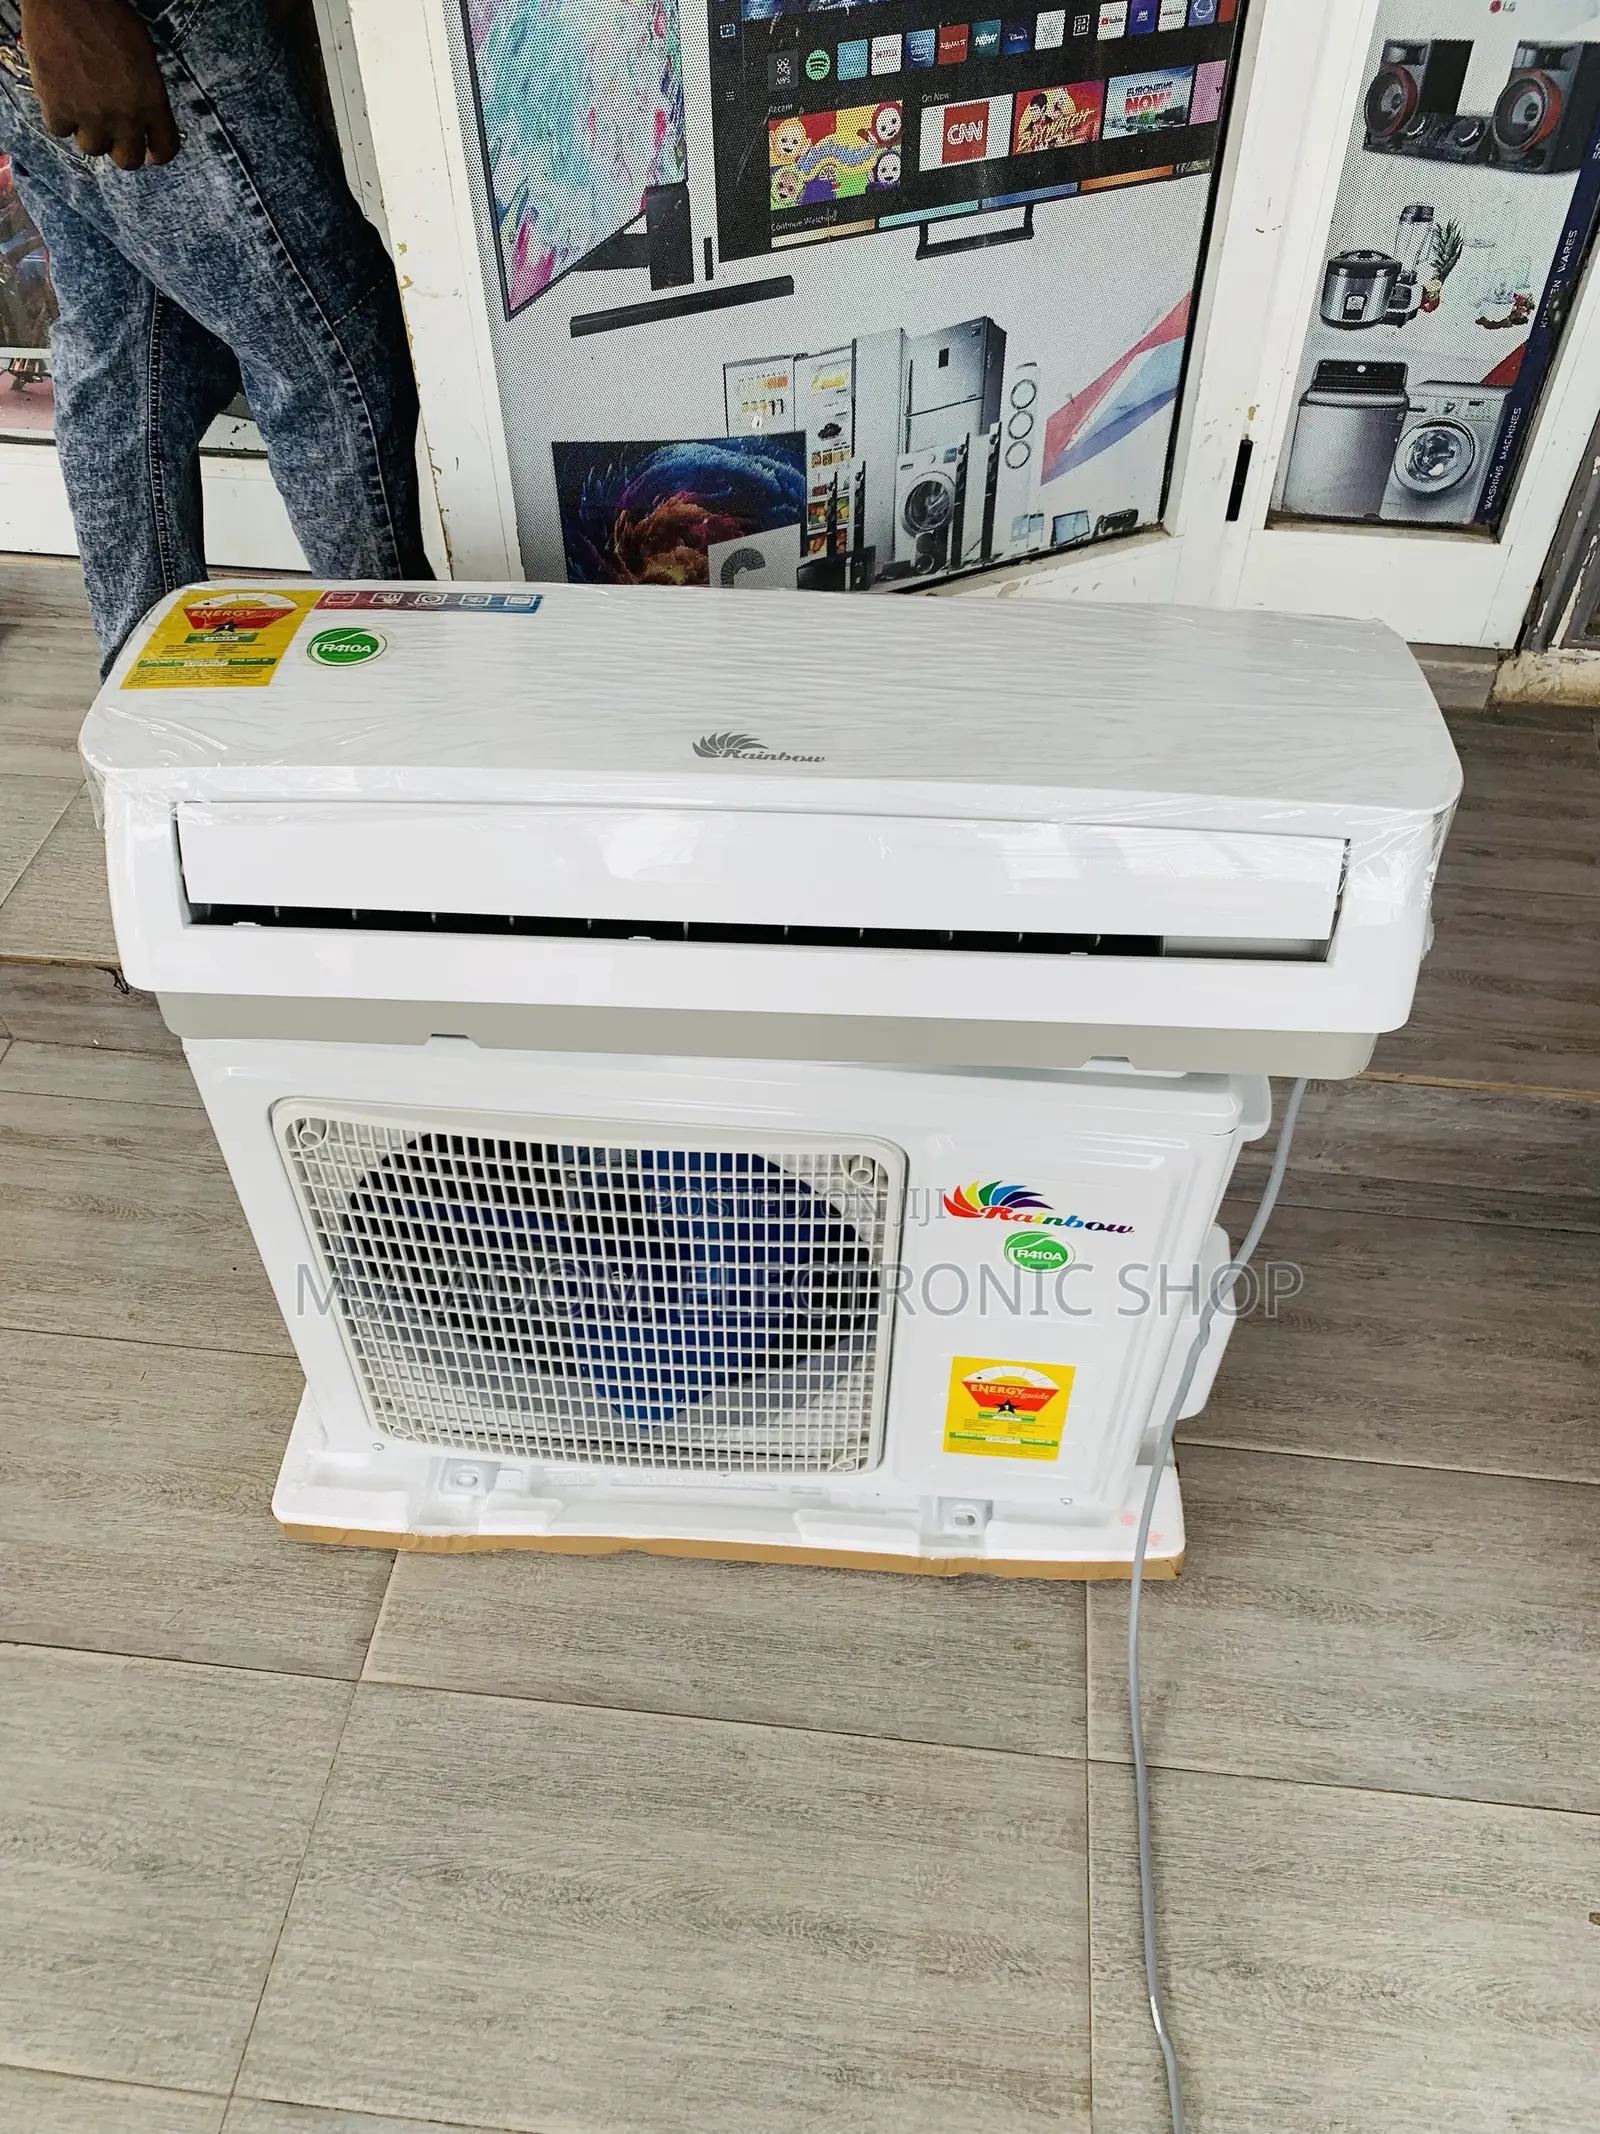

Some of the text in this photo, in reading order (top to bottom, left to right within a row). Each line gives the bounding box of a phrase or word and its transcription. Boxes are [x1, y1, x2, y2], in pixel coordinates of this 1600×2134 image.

[946, 120, 984, 145] CNN
[1556, 229, 1578, 273] WARES
[1484, 407, 1522, 510] WASHING MACHINES
[191, 609, 254, 618] ENERGY
[320, 643, 372, 653] R410A
[719, 748, 826, 763] Rainbow
[980, 1205, 1135, 1233] Rainbow
[1016, 1249, 1064, 1262] R410A
[970, 1383, 1025, 1396] ENERGY
